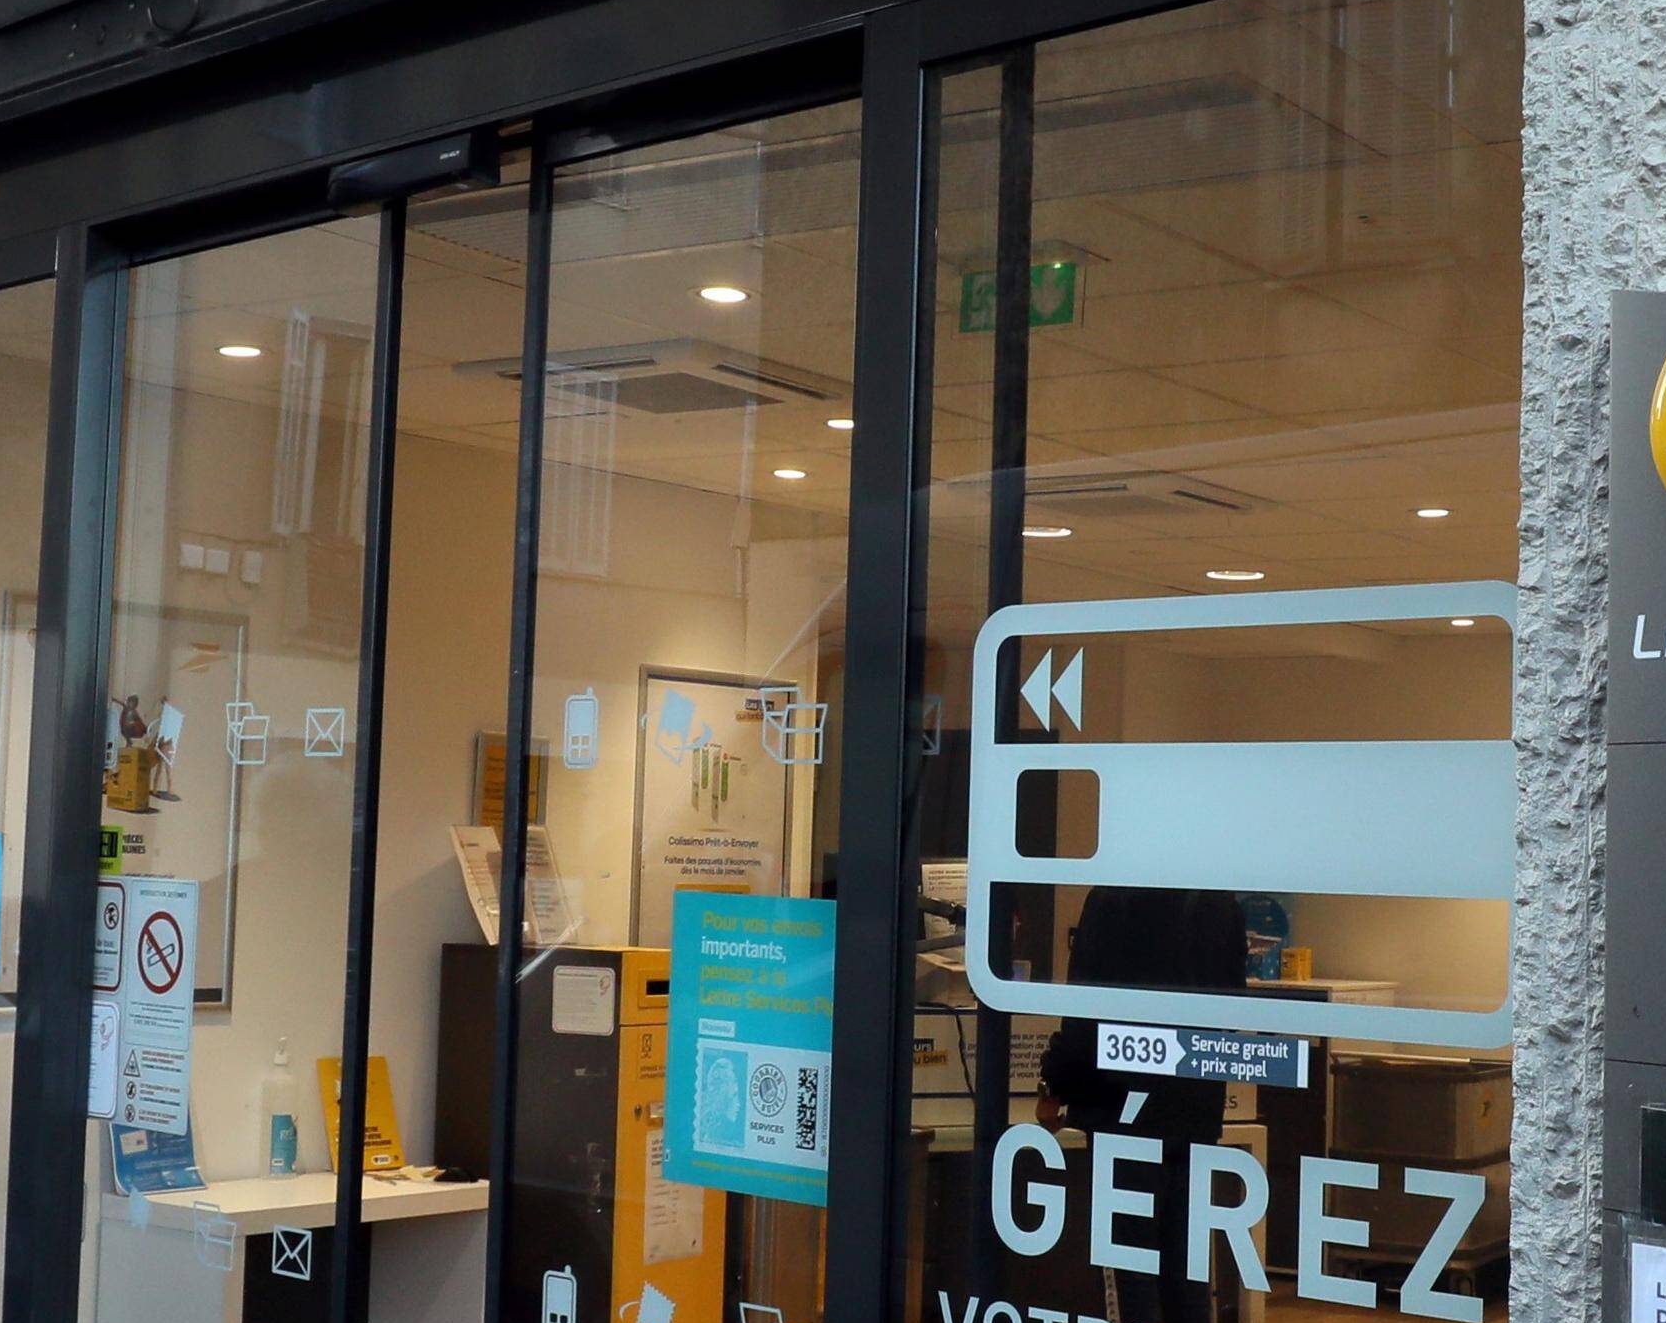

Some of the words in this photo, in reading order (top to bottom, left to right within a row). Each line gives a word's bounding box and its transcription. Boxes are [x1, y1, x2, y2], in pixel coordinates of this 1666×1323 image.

[668, 836, 704, 847] Colissimo
[703, 910, 738, 930] Pour
[741, 918, 766, 933] vos
[701, 936, 786, 963] importants,
[701, 965, 753, 982] pensez
[700, 987, 740, 1006] Lettre
[745, 990, 811, 1013] Services
[1106, 1034, 1167, 1064] 3639
[1191, 1034, 1240, 1055] Service
[1242, 1041, 1289, 1060] gratuit
[1201, 1057, 1227, 1077] prix
[1230, 1060, 1267, 1081] appel
[750, 1121, 784, 1134] SERVICES
[757, 1135, 776, 1145] PLUS
